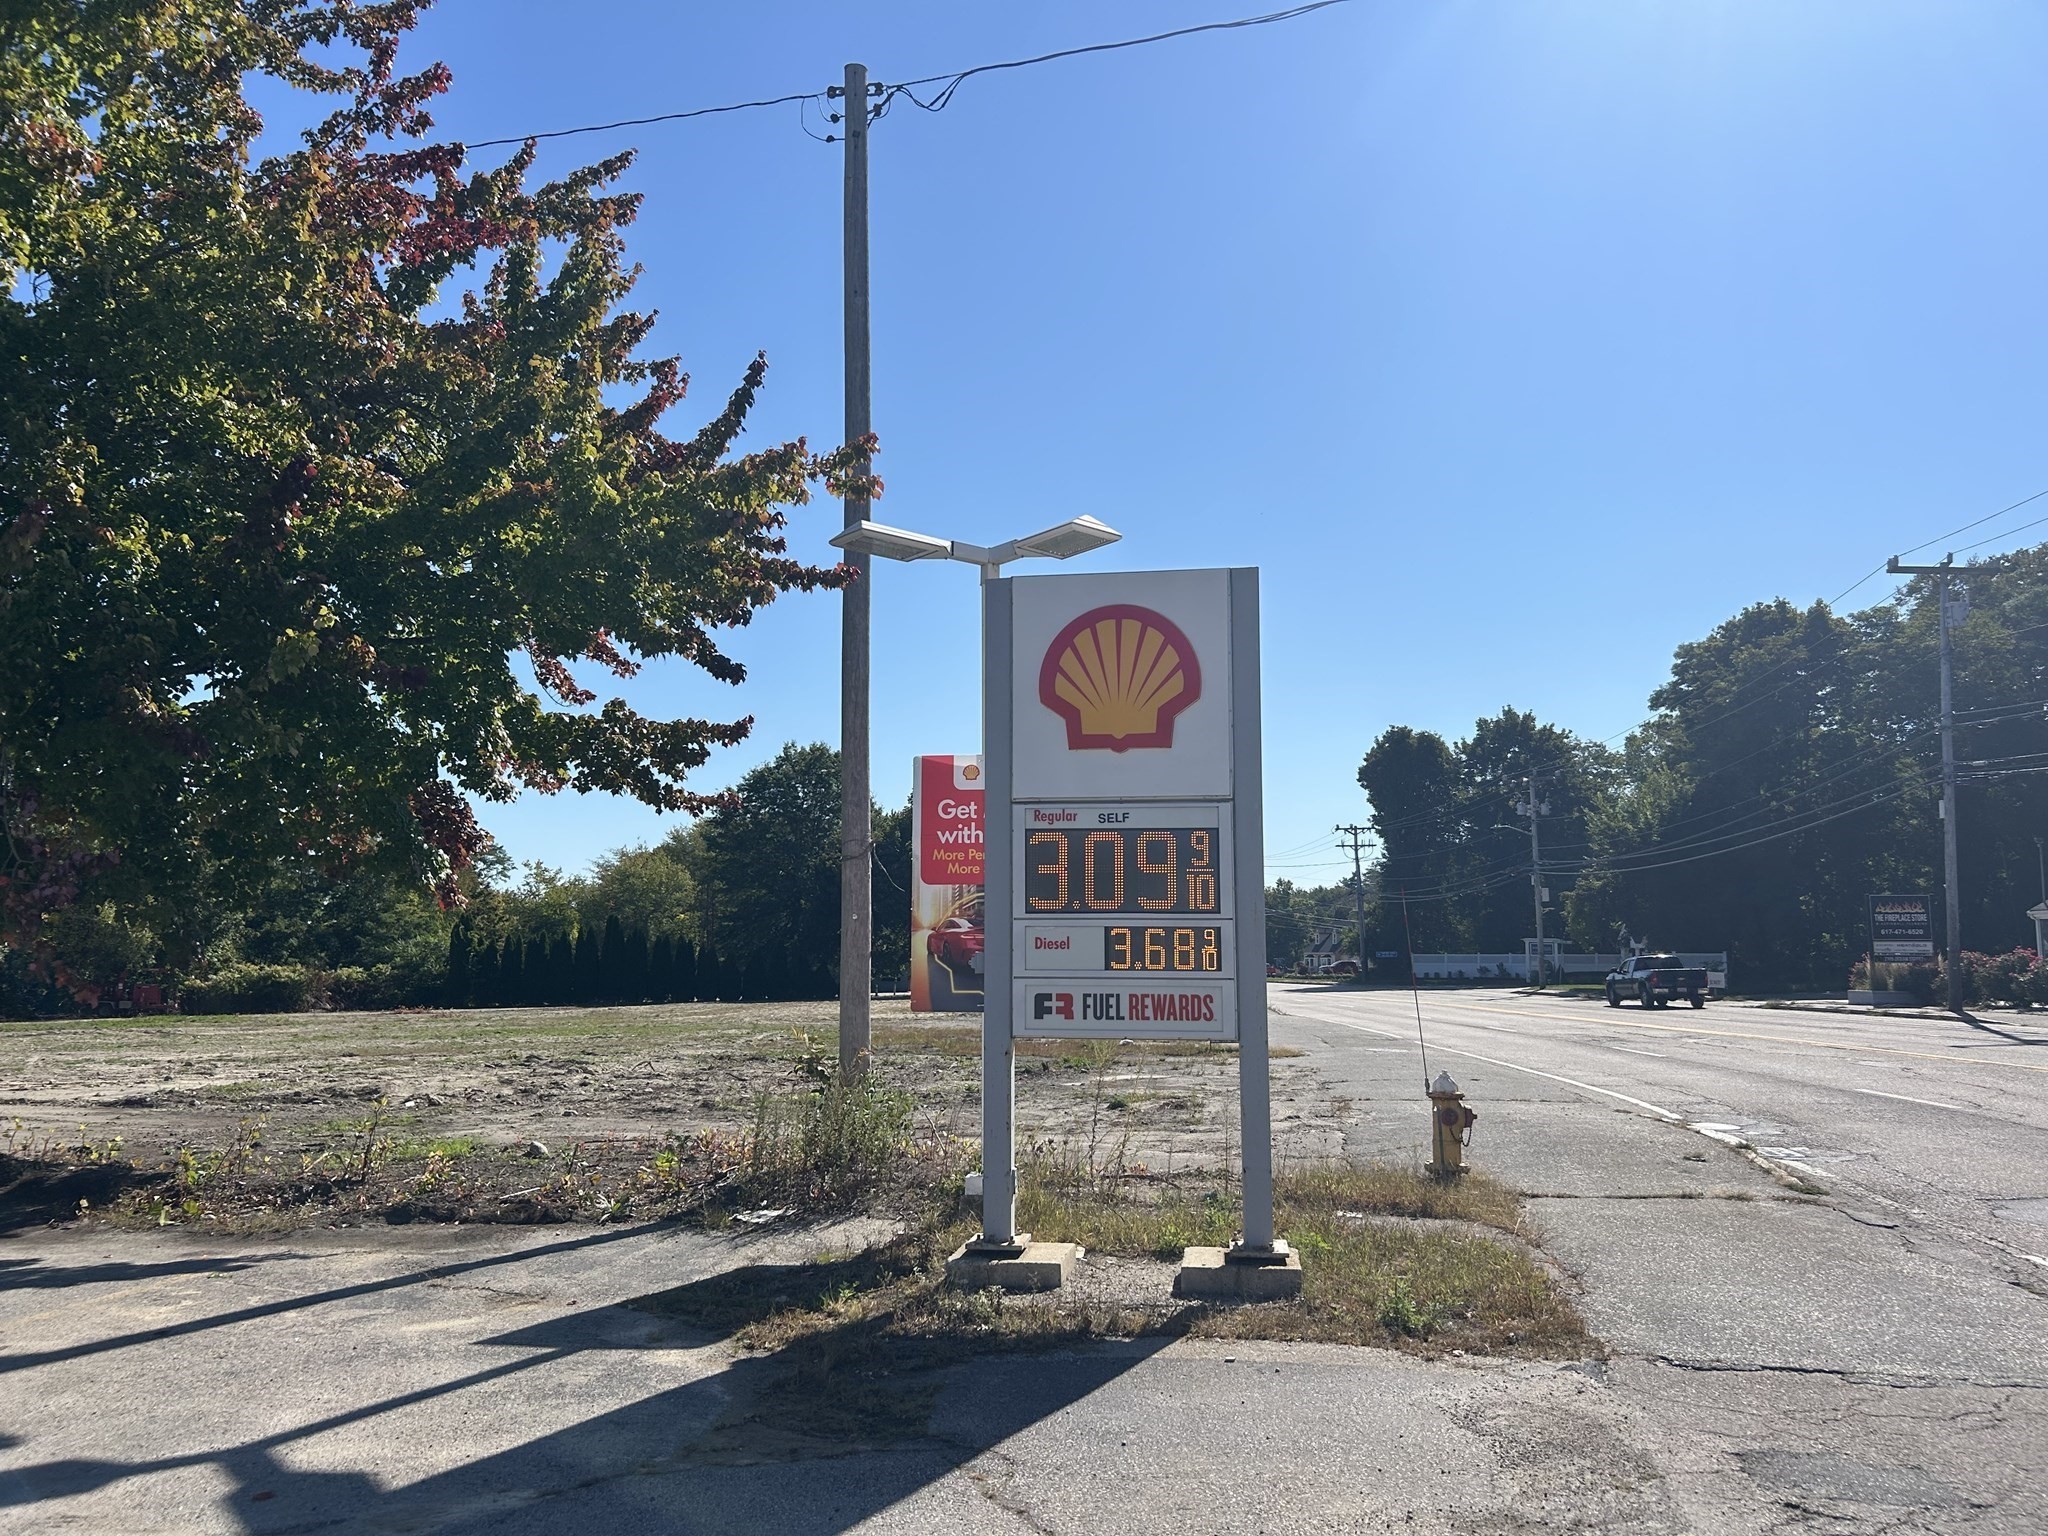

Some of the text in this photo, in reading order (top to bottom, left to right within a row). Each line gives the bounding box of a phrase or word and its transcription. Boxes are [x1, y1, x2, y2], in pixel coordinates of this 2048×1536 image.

[937, 799, 978, 819] Get
[1033, 809, 1130, 825] Regular SELF
[936, 822, 984, 844] with
[932, 849, 965, 861] More
[947, 863, 980, 874] More
[1029, 831, 1177, 910] 3.09
[1034, 936, 1070, 950] Diesel
[1110, 928, 1196, 970] 3.68
[1082, 992, 1126, 1021] FUEL
[1128, 993, 1215, 1022] REWARDS
